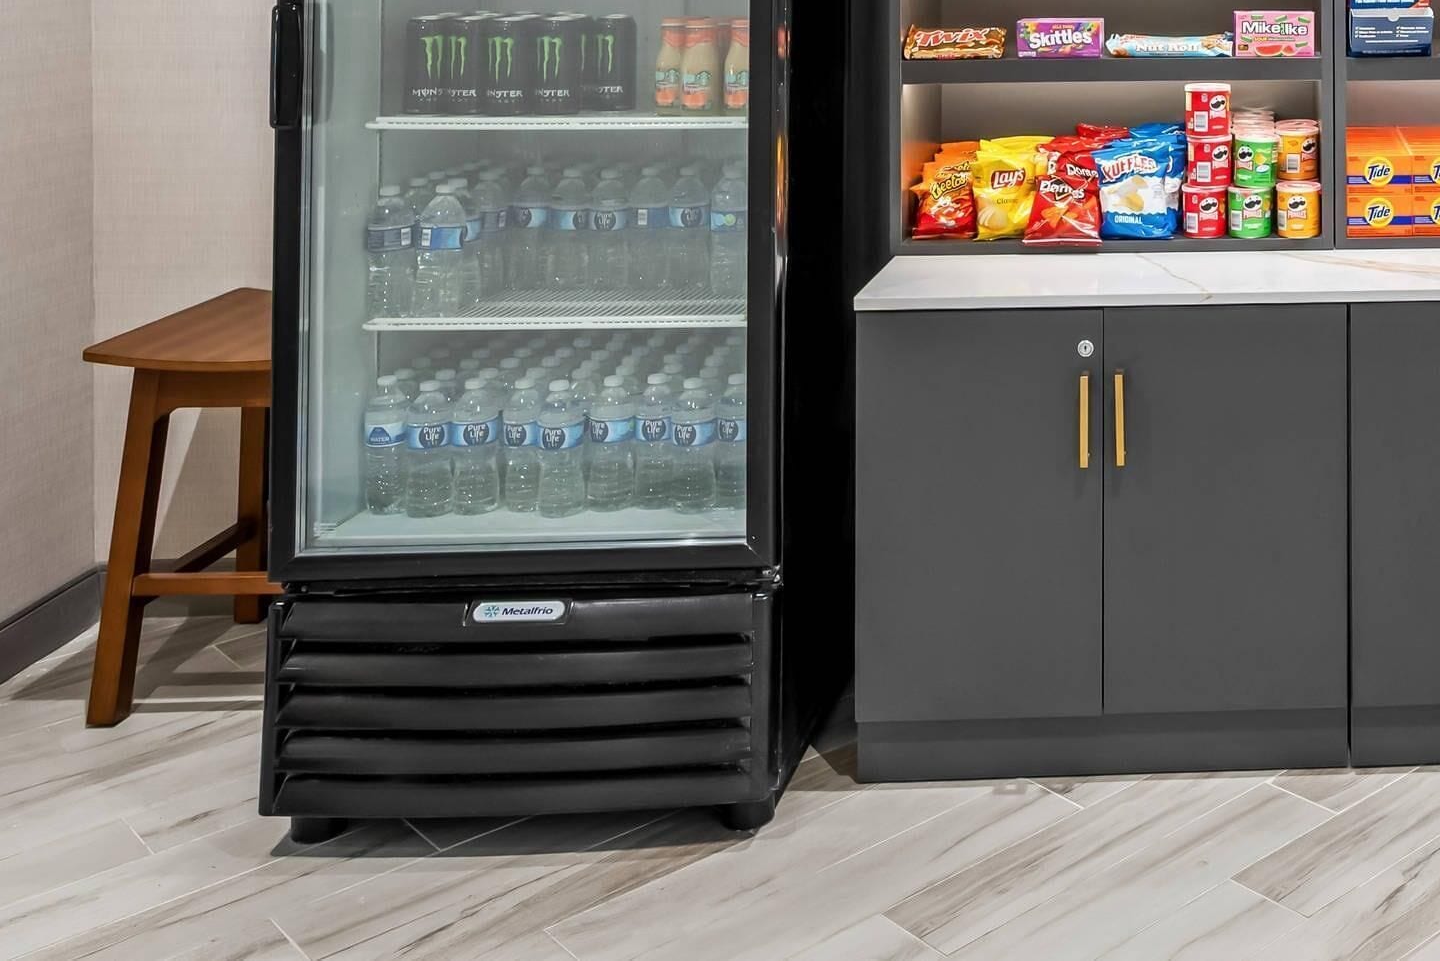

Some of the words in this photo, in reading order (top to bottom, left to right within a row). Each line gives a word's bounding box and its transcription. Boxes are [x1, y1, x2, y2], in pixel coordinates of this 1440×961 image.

[1242, 21, 1281, 35] Mike
[1029, 28, 1093, 49] Skittles
[1135, 42, 1165, 52] Nut
[993, 167, 1024, 189] Lay's
[1367, 165, 1391, 180] Tide
[1367, 205, 1391, 221] Tide
[1114, 215, 1143, 225] ORIGINAL
[423, 426, 441, 434] Pure
[467, 424, 486, 432] Pure
[470, 431, 485, 442] Life
[501, 606, 553, 616] Metalfrio
